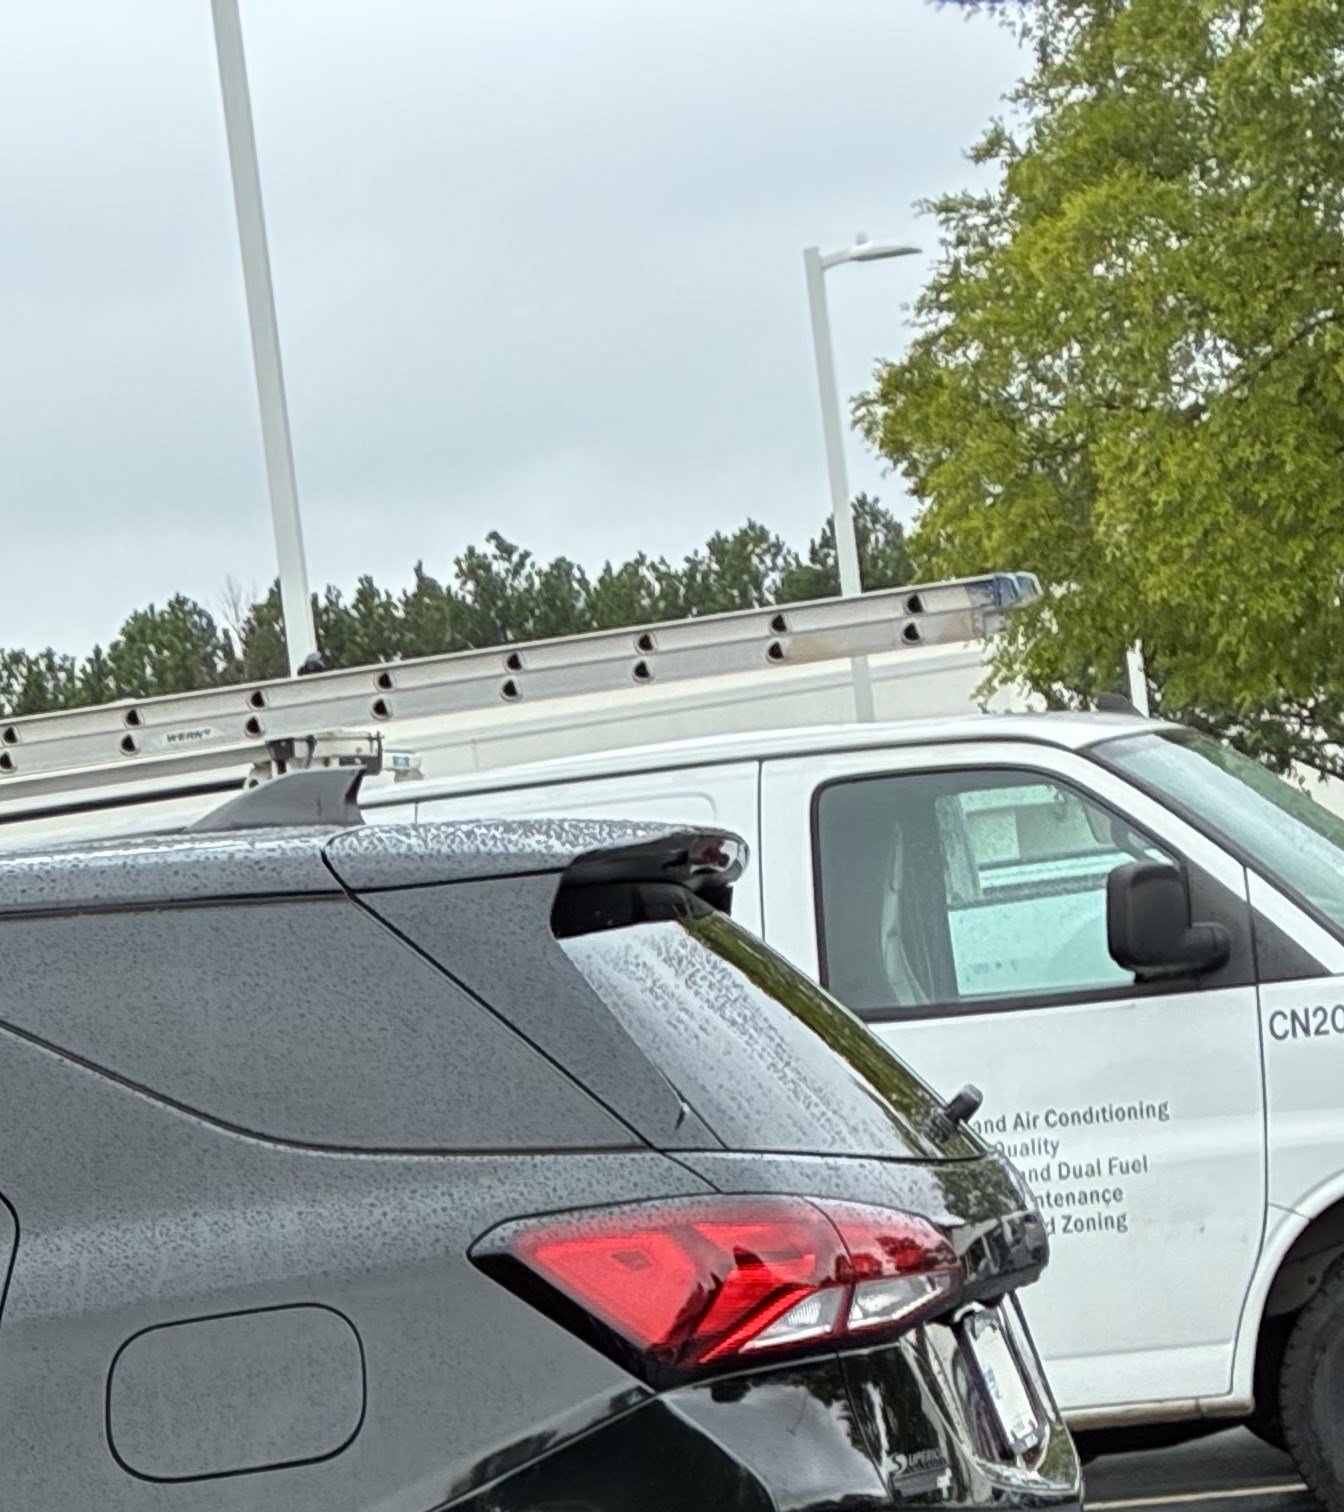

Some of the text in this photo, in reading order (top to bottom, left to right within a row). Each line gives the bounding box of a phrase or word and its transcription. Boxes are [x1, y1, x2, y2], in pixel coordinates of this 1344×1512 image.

[1013, 1110, 1040, 1130] Air
[1044, 1100, 1171, 1128] Conditioning
[1021, 1154, 1149, 1183] nd Dual Fuel
[1034, 1187, 1125, 1209] ntenance
[1061, 1212, 1129, 1234] Zoning
